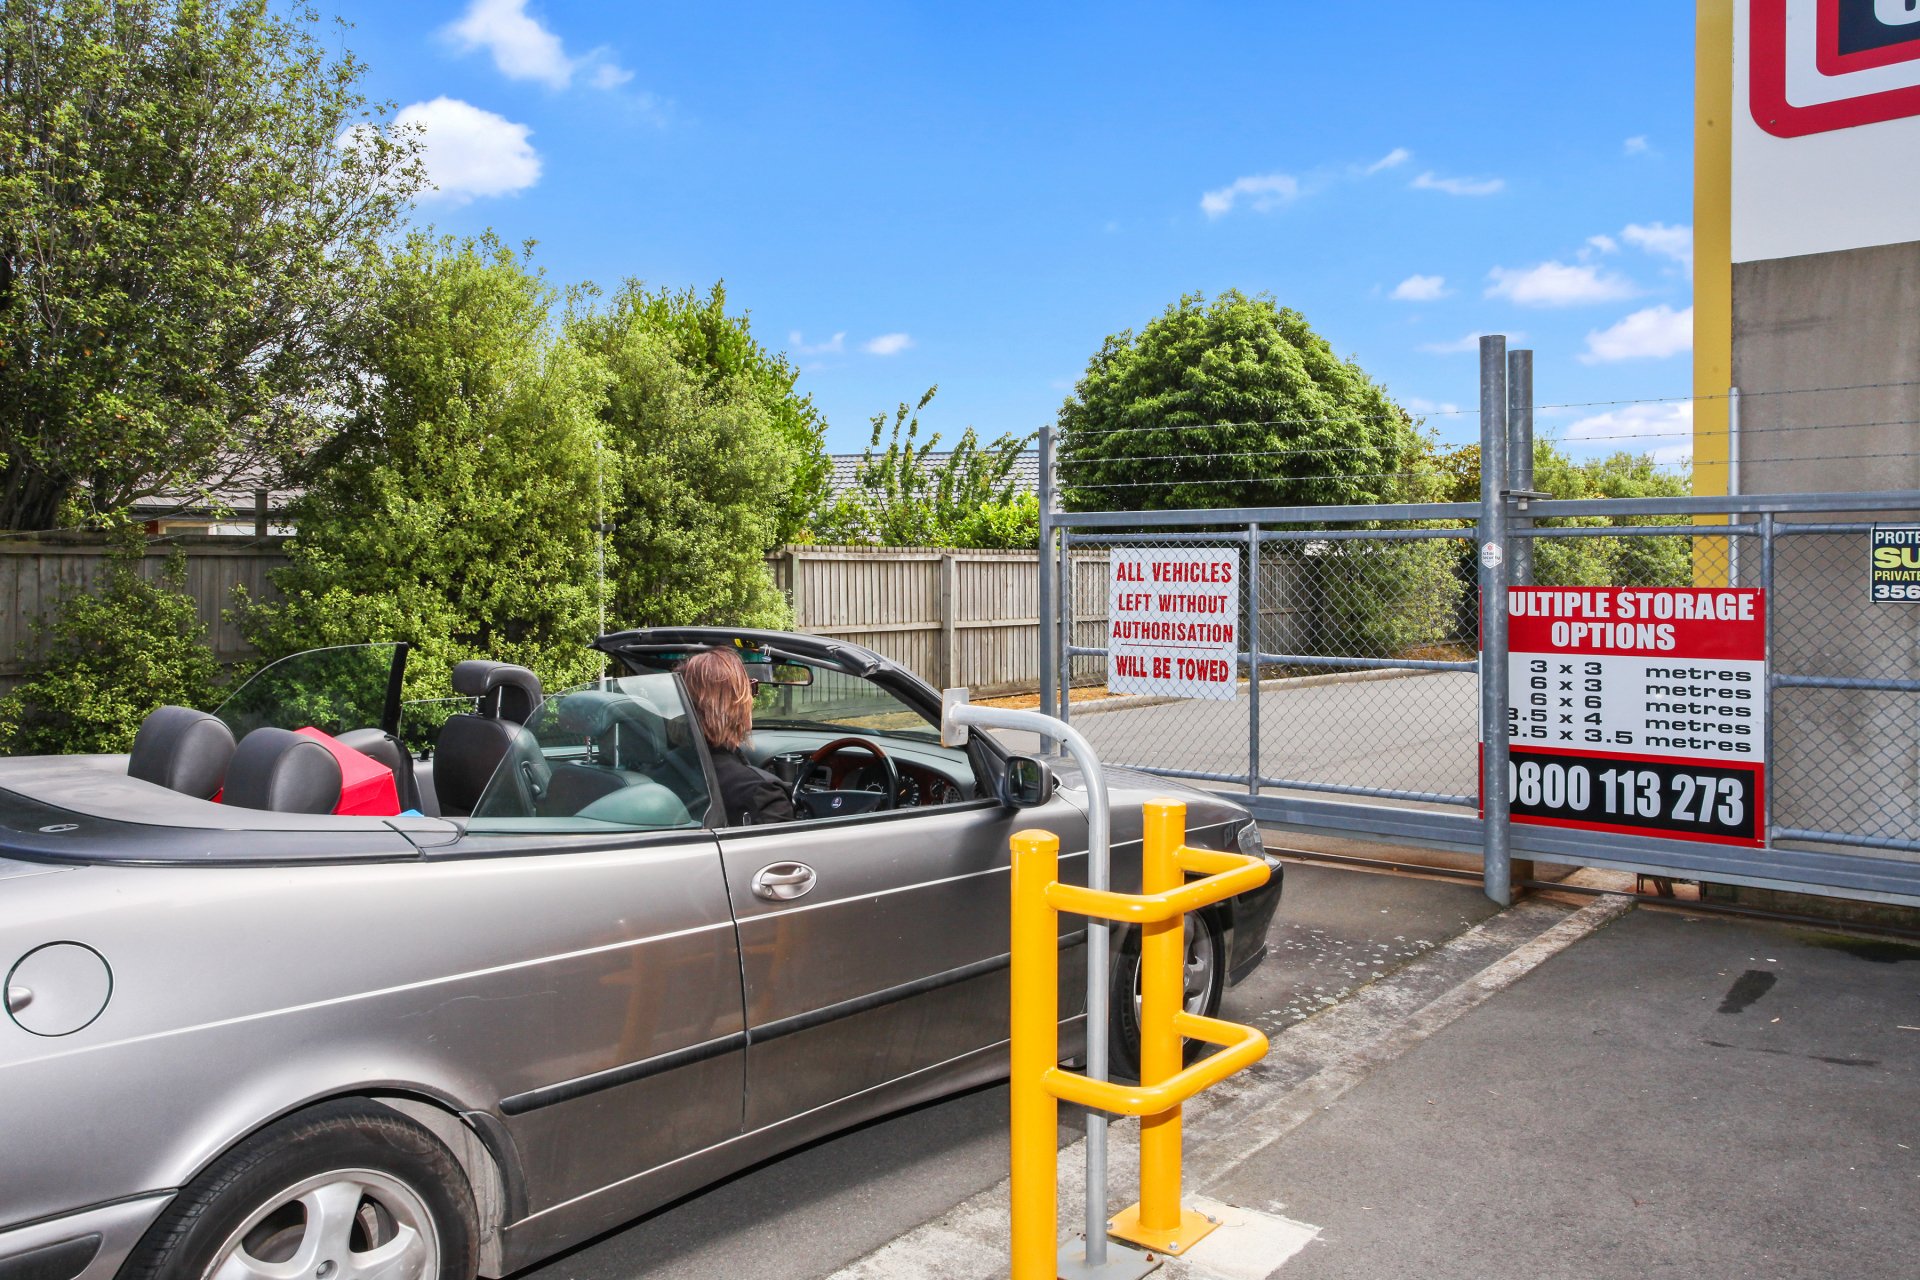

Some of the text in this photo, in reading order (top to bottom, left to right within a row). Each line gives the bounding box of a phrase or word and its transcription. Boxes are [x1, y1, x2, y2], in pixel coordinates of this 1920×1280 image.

[1116, 562, 1232, 583] ALL VEHICLES
[1875, 571, 1920, 581] PRIVATE
[1874, 584, 1920, 599] 356
[1118, 594, 1228, 614] LEFT WITHOUT
[1509, 592, 1755, 621] ULTIPLE STORAGE
[1113, 621, 1233, 643] AUTHORISATION
[1551, 621, 1676, 650] OPTIONS
[1116, 655, 1229, 682] WILL BE TOWED
[1530, 660, 1752, 682] 3 x 3 metres
[1530, 676, 1752, 700] 6 x 3 metres
[1530, 693, 1752, 717] 6 x 6 metres
[1559, 713, 1573, 724] x
[1584, 712, 1602, 725] 4
[1645, 718, 1752, 735] metres
[1559, 730, 1573, 740] x
[1585, 729, 1633, 745] 3.5
[1645, 735, 1752, 752] metres
[1599, 768, 1661, 818] 113
[1671, 774, 1744, 826] 273
